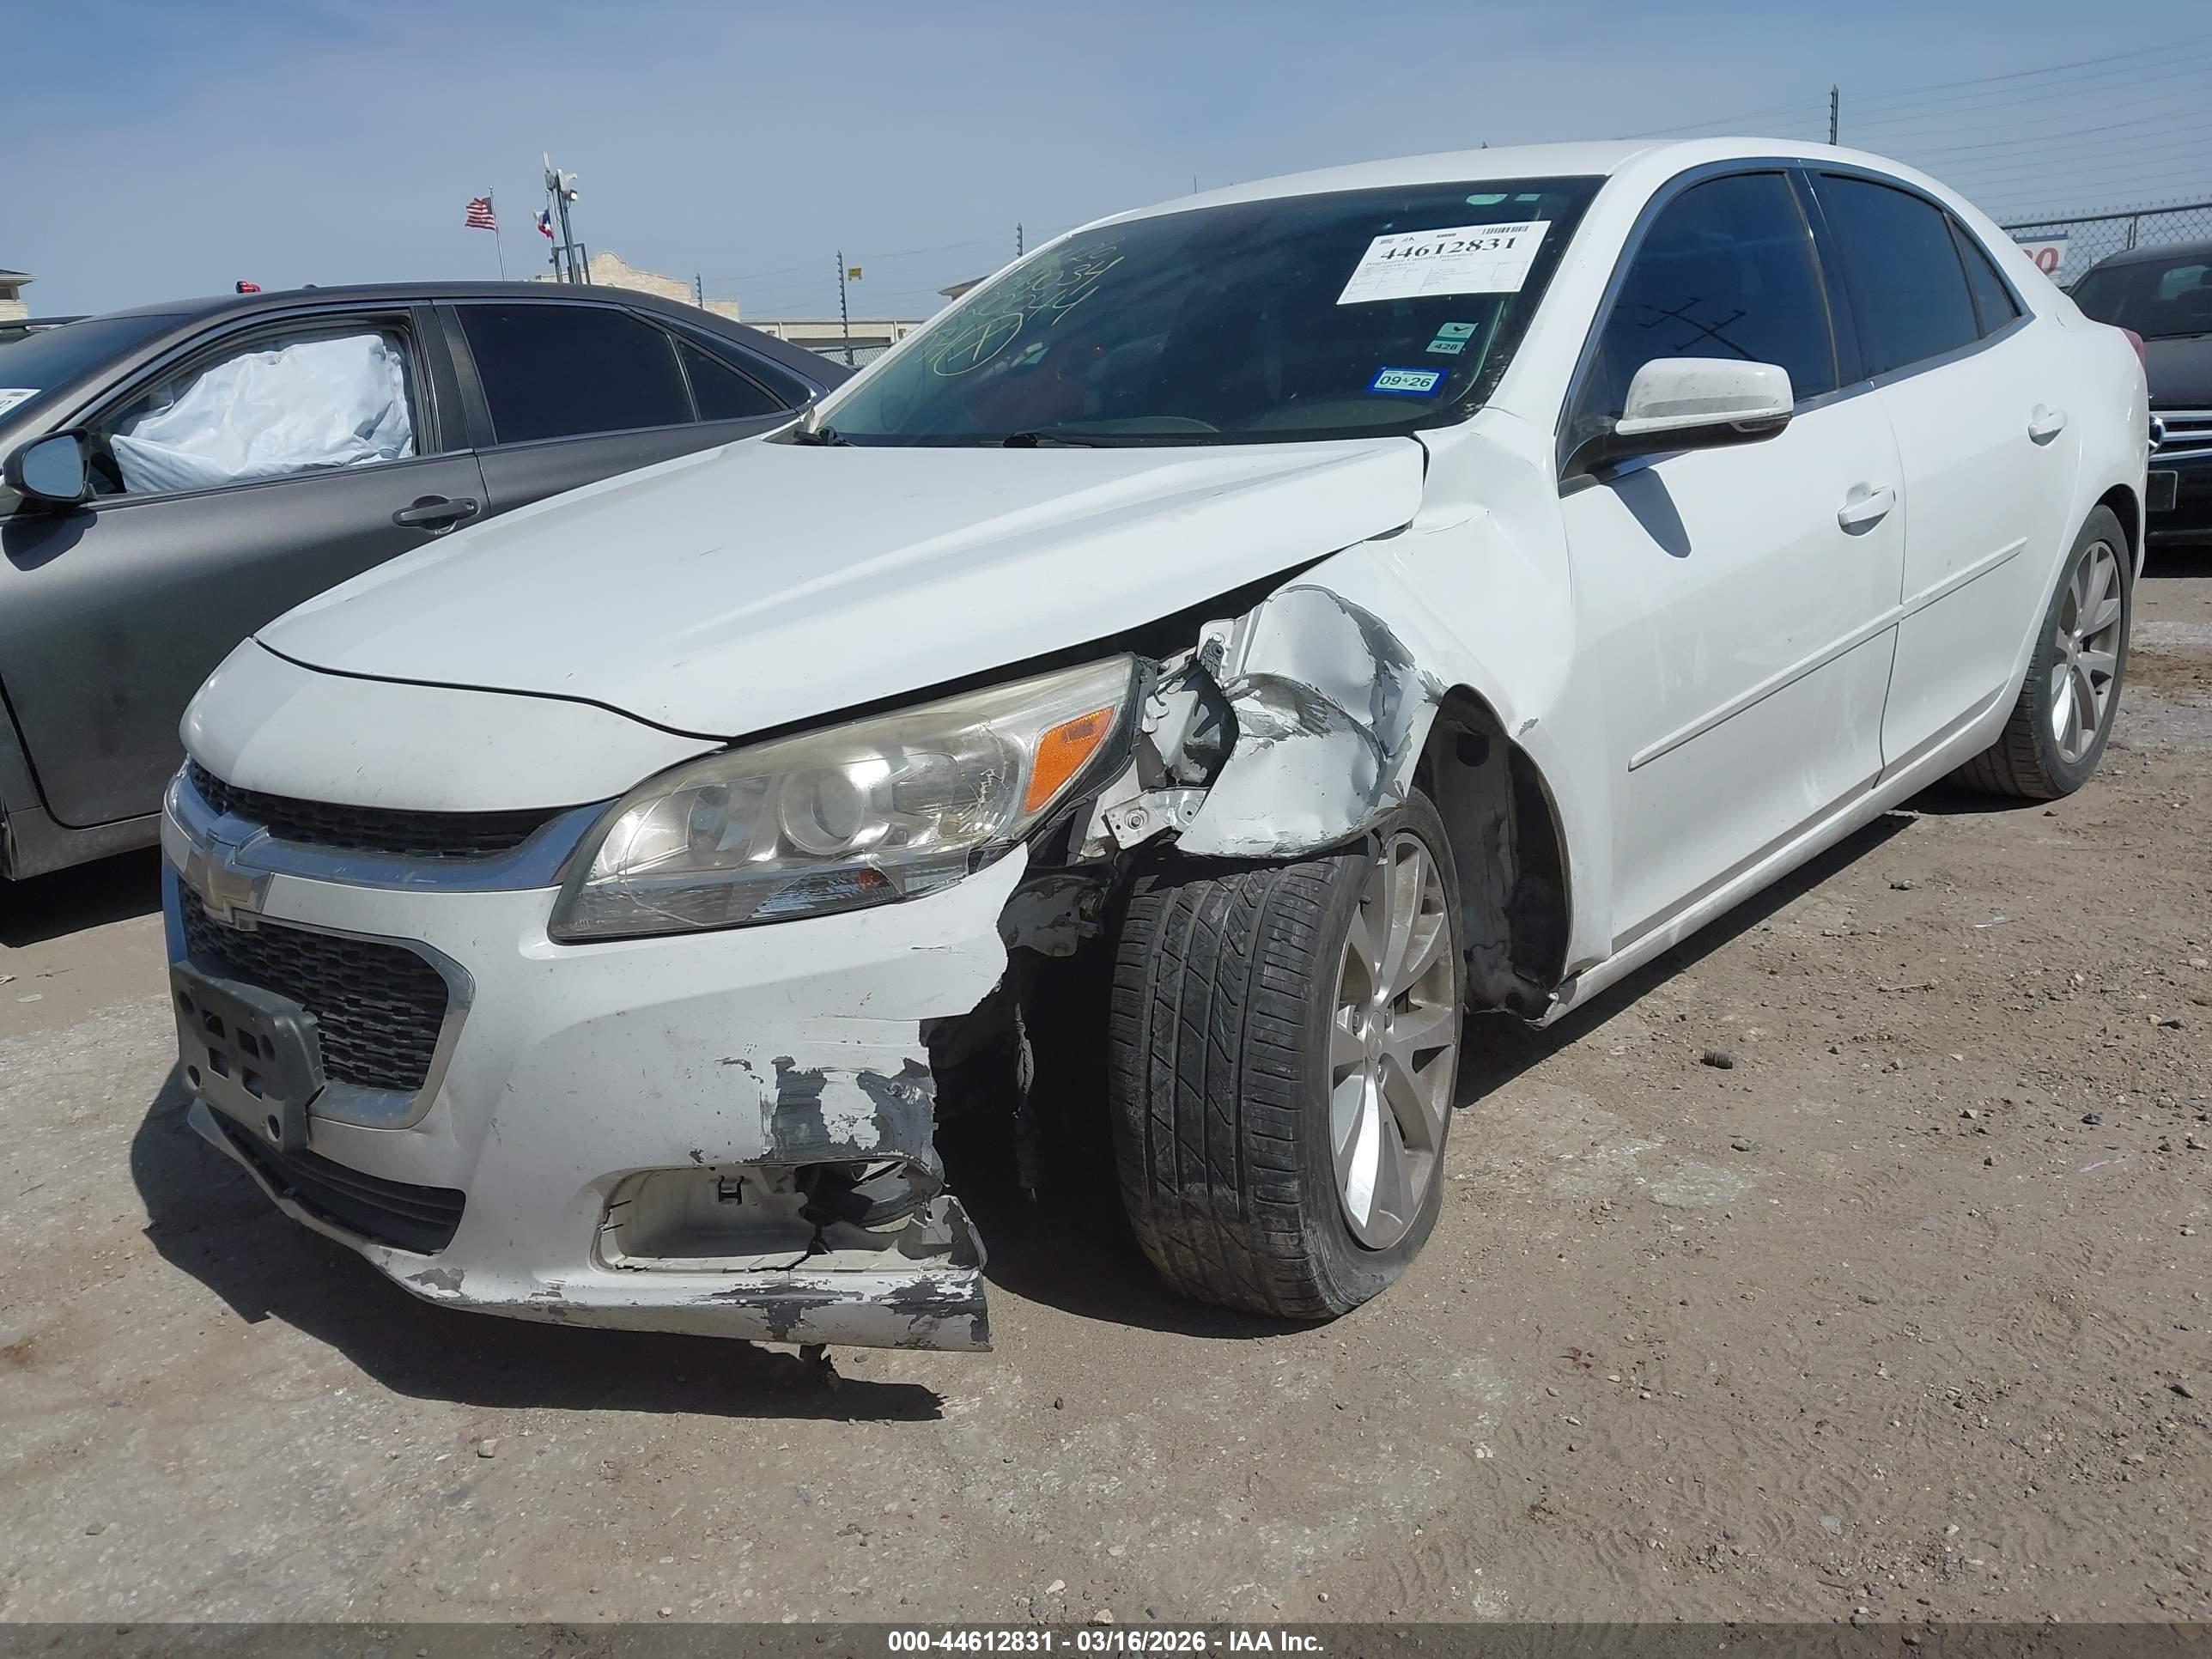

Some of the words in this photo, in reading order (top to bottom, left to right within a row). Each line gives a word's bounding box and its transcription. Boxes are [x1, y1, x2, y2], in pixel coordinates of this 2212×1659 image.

[1380, 236, 1516, 260] 44612831
[1379, 375, 1402, 386] 09
[1408, 377, 1432, 387] 26
